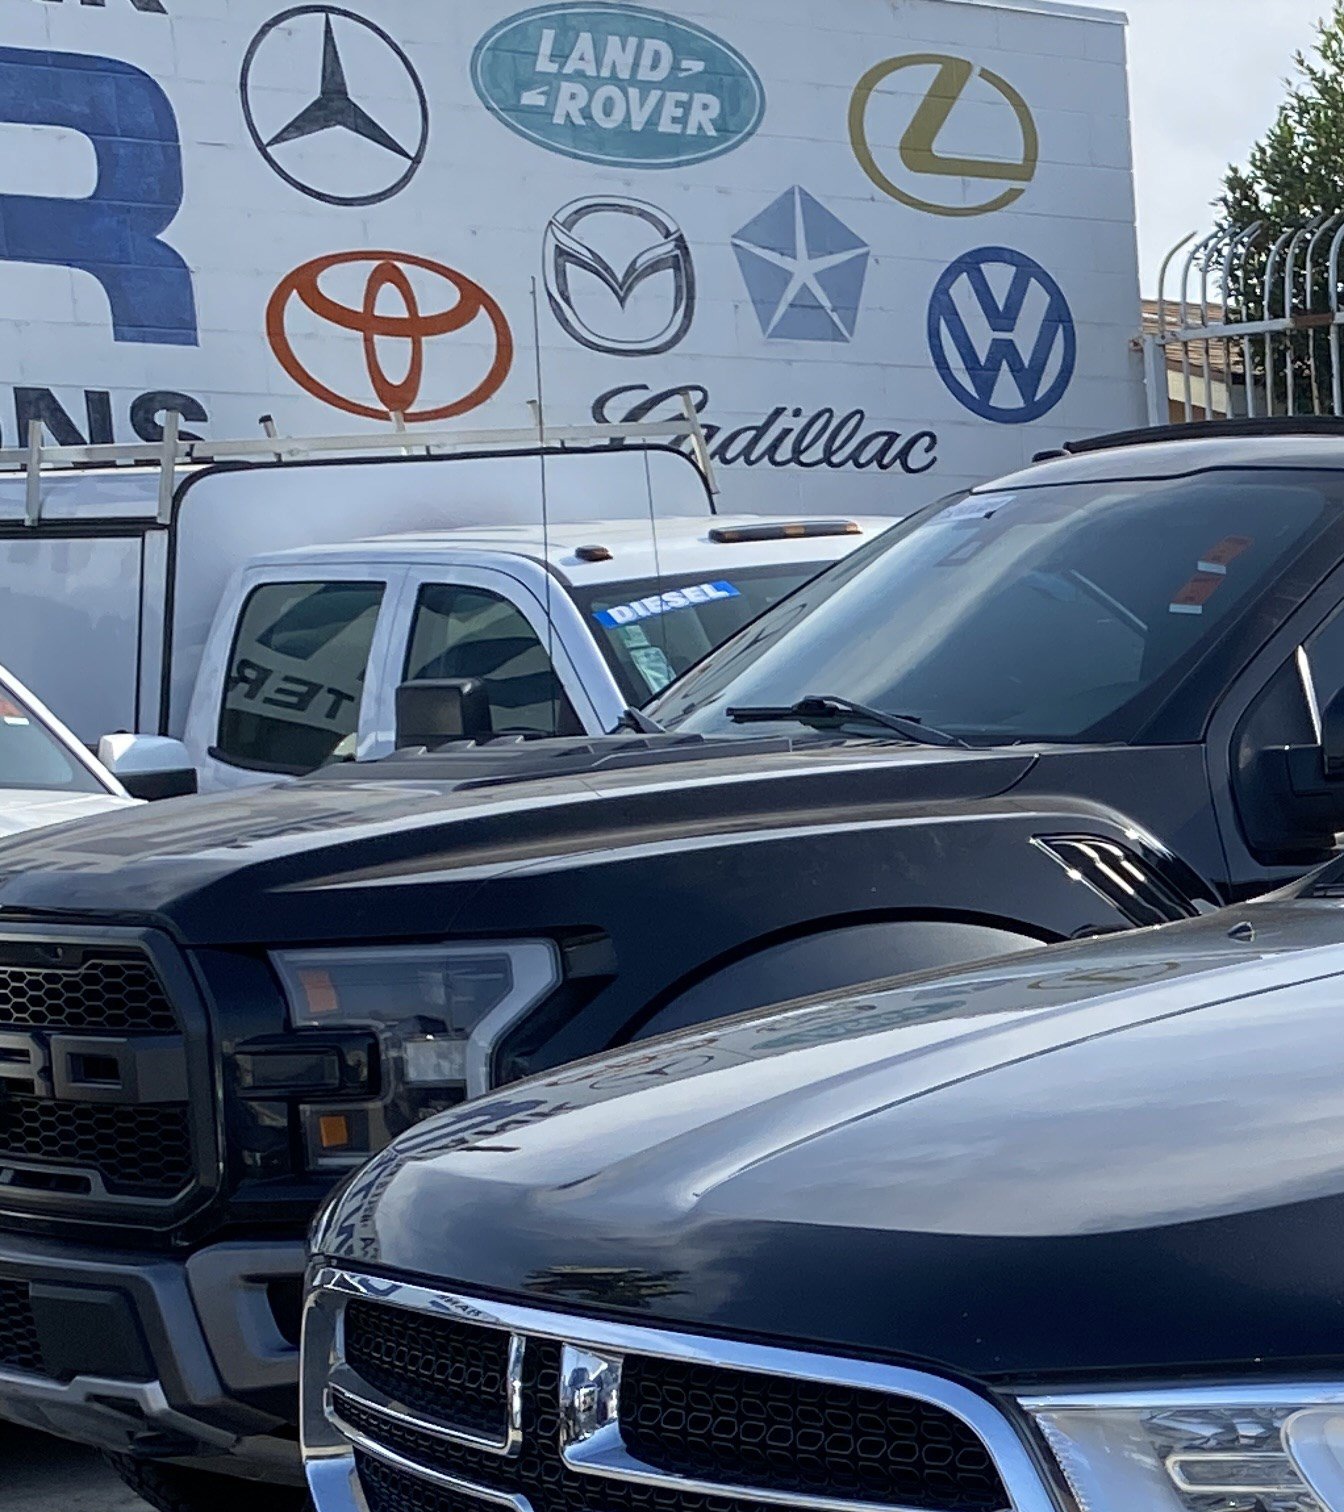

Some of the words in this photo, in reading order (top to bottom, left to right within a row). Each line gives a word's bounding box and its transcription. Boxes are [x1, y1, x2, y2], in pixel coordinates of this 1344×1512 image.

[535, 28, 674, 82] LAND
[552, 83, 721, 136] ROVER
[0, 386, 209, 466] NS
[591, 384, 938, 475] Cadillac
[606, 583, 731, 625] DIESEL
